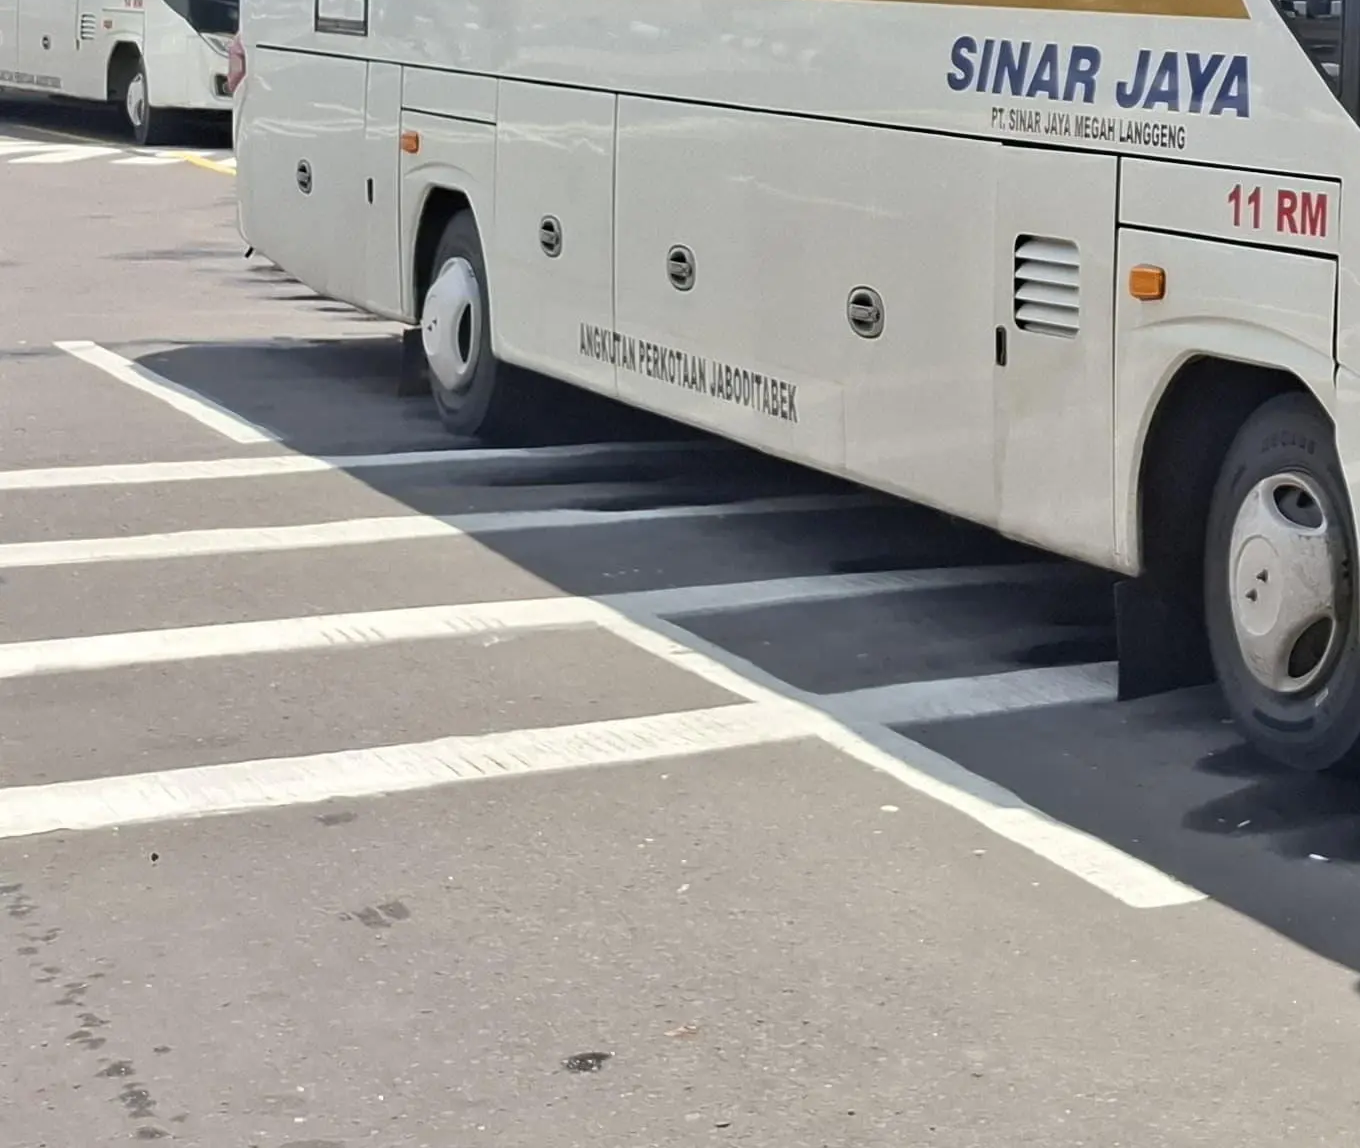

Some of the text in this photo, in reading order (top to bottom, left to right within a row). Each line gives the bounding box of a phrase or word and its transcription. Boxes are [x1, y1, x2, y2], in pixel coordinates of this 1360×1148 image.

[947, 36, 1250, 118] SINAR JAYA
[992, 107, 1186, 150] PT. SINAR JAYA MEGAH LANGGENG
[1228, 184, 1328, 237] 11 RM
[580, 322, 798, 423] ANGKUTAN PERKOTAAN JABODITABEK
